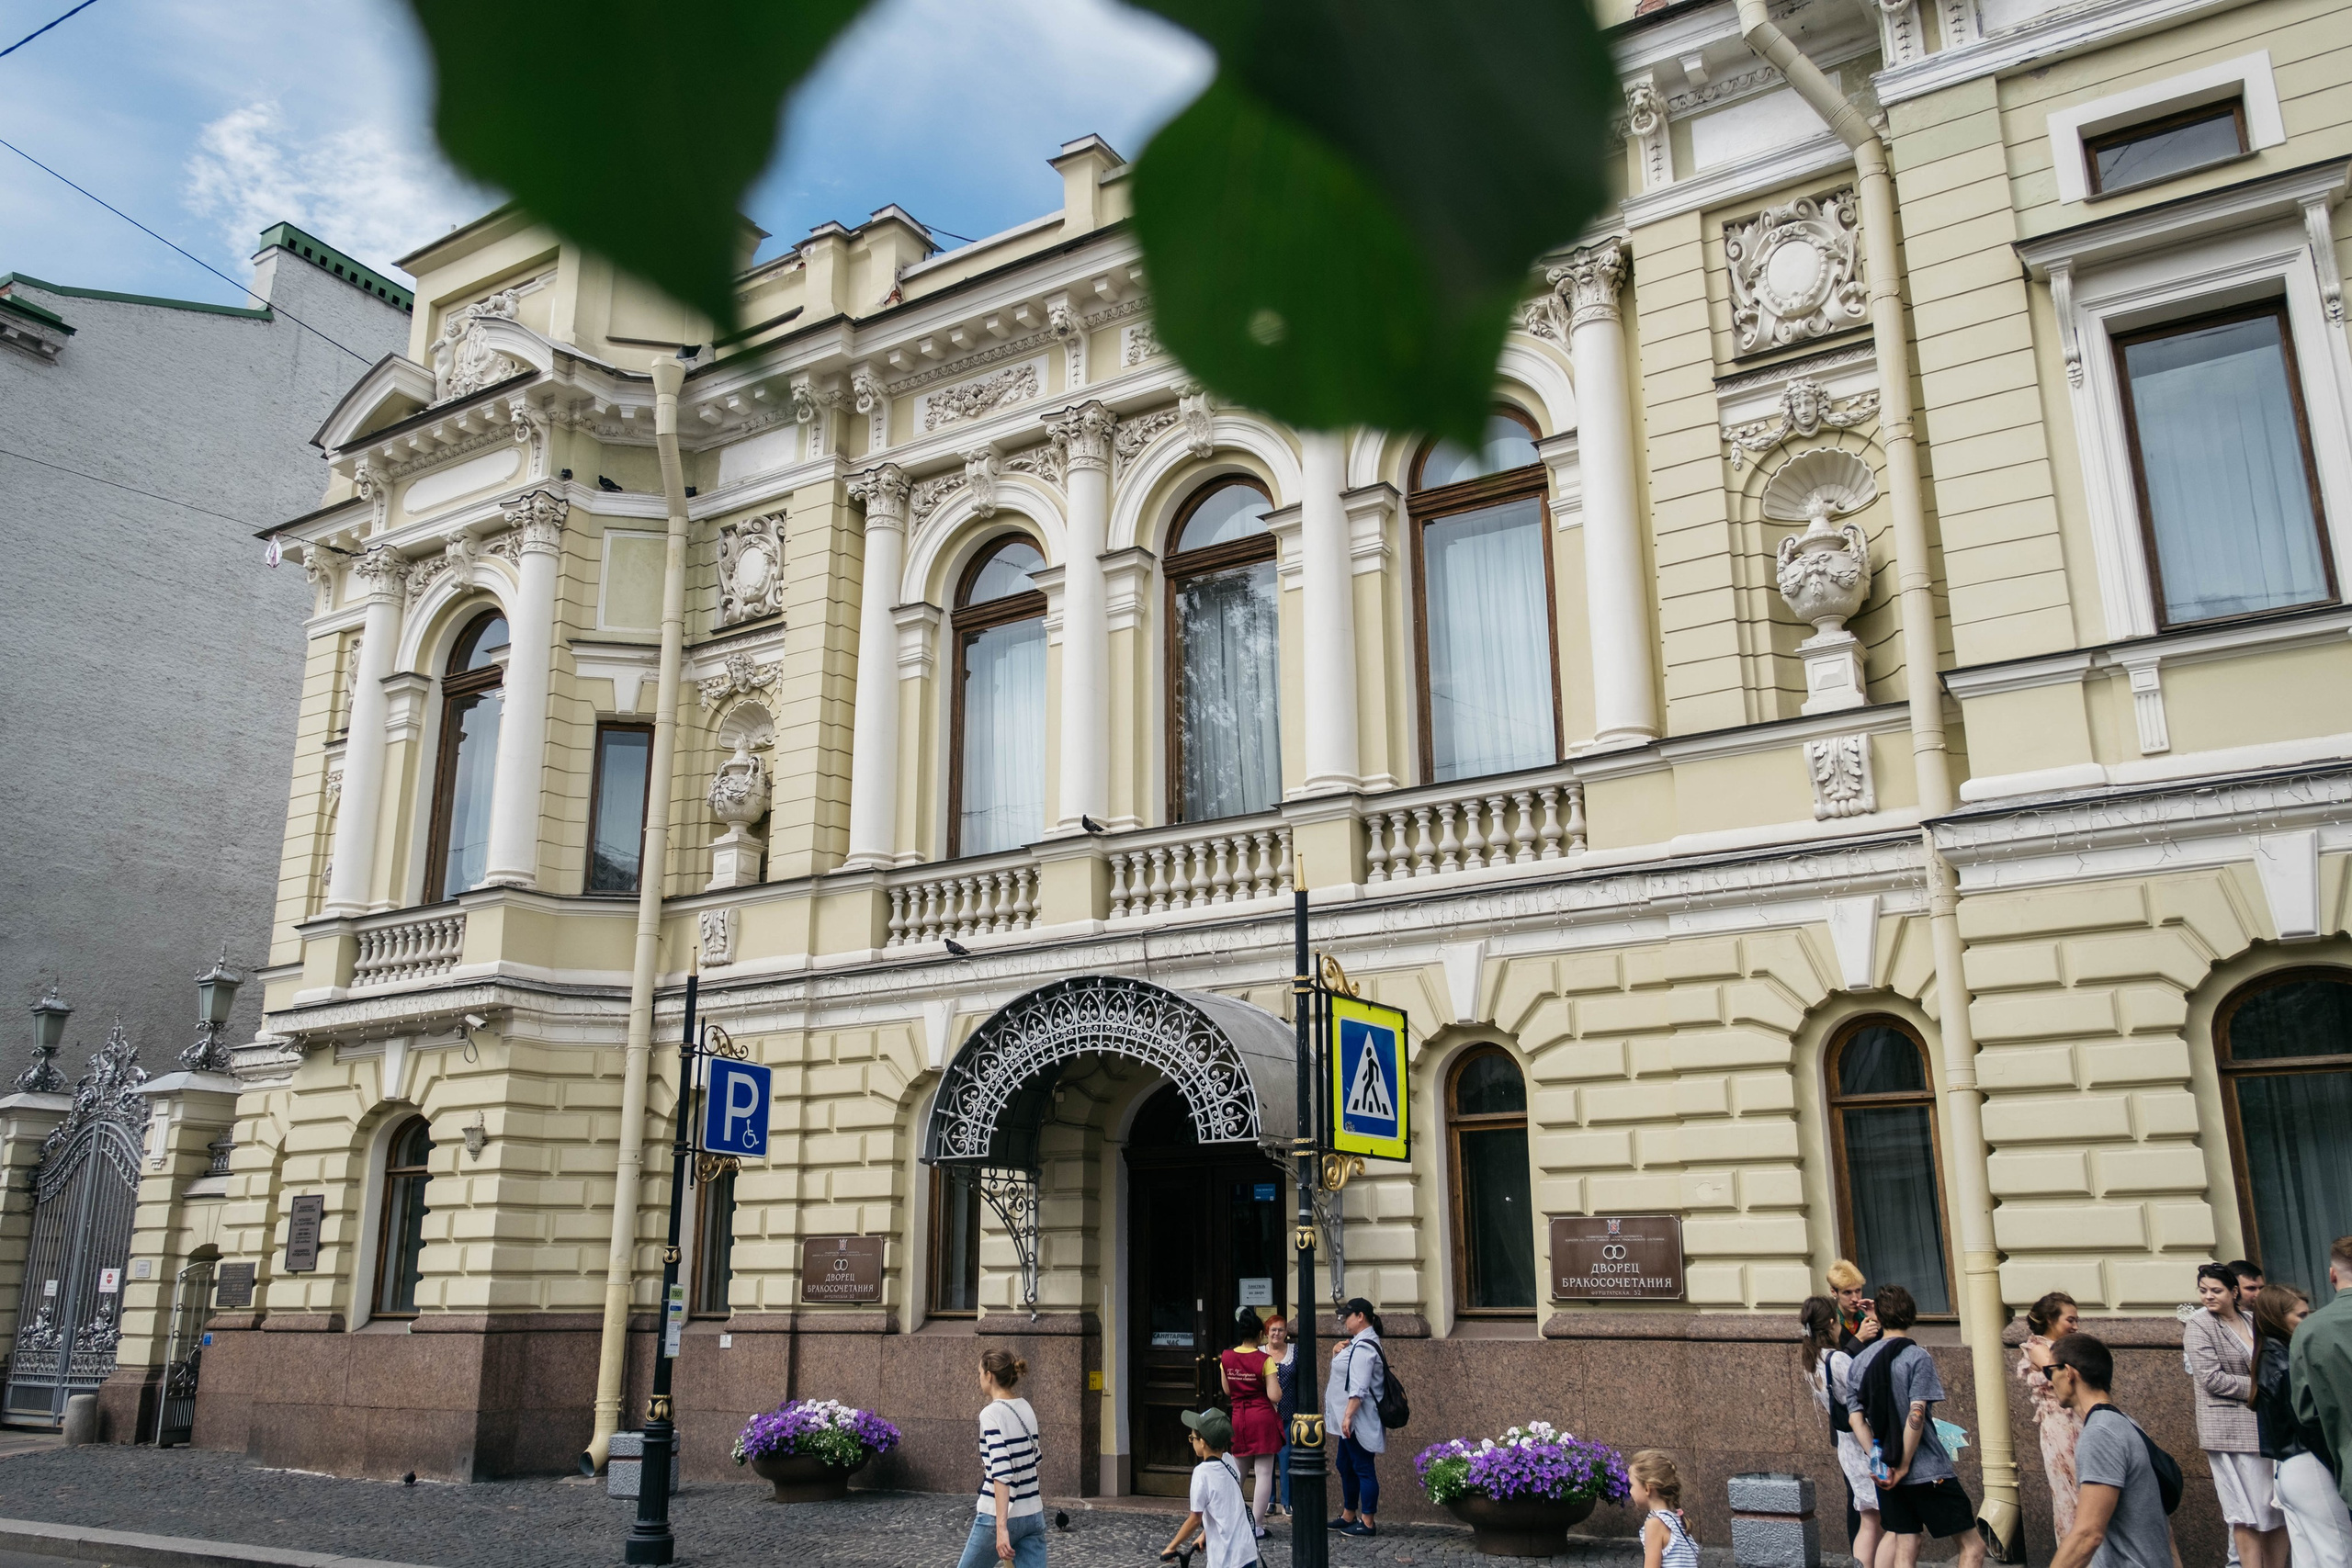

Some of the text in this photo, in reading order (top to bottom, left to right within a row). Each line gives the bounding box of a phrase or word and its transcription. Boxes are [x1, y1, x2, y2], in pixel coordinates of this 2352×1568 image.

[723, 1071, 759, 1142] P
[1590, 1263, 1640, 1274] ДВОРЕЦ
[825, 1273, 855, 1282] ДВОРЕЦ
[1562, 1278, 1672, 1288] БРАКОСОЧЕТАНИЯ
[808, 1284, 874, 1293] БРАКОСОЧЕТАНИЯ
